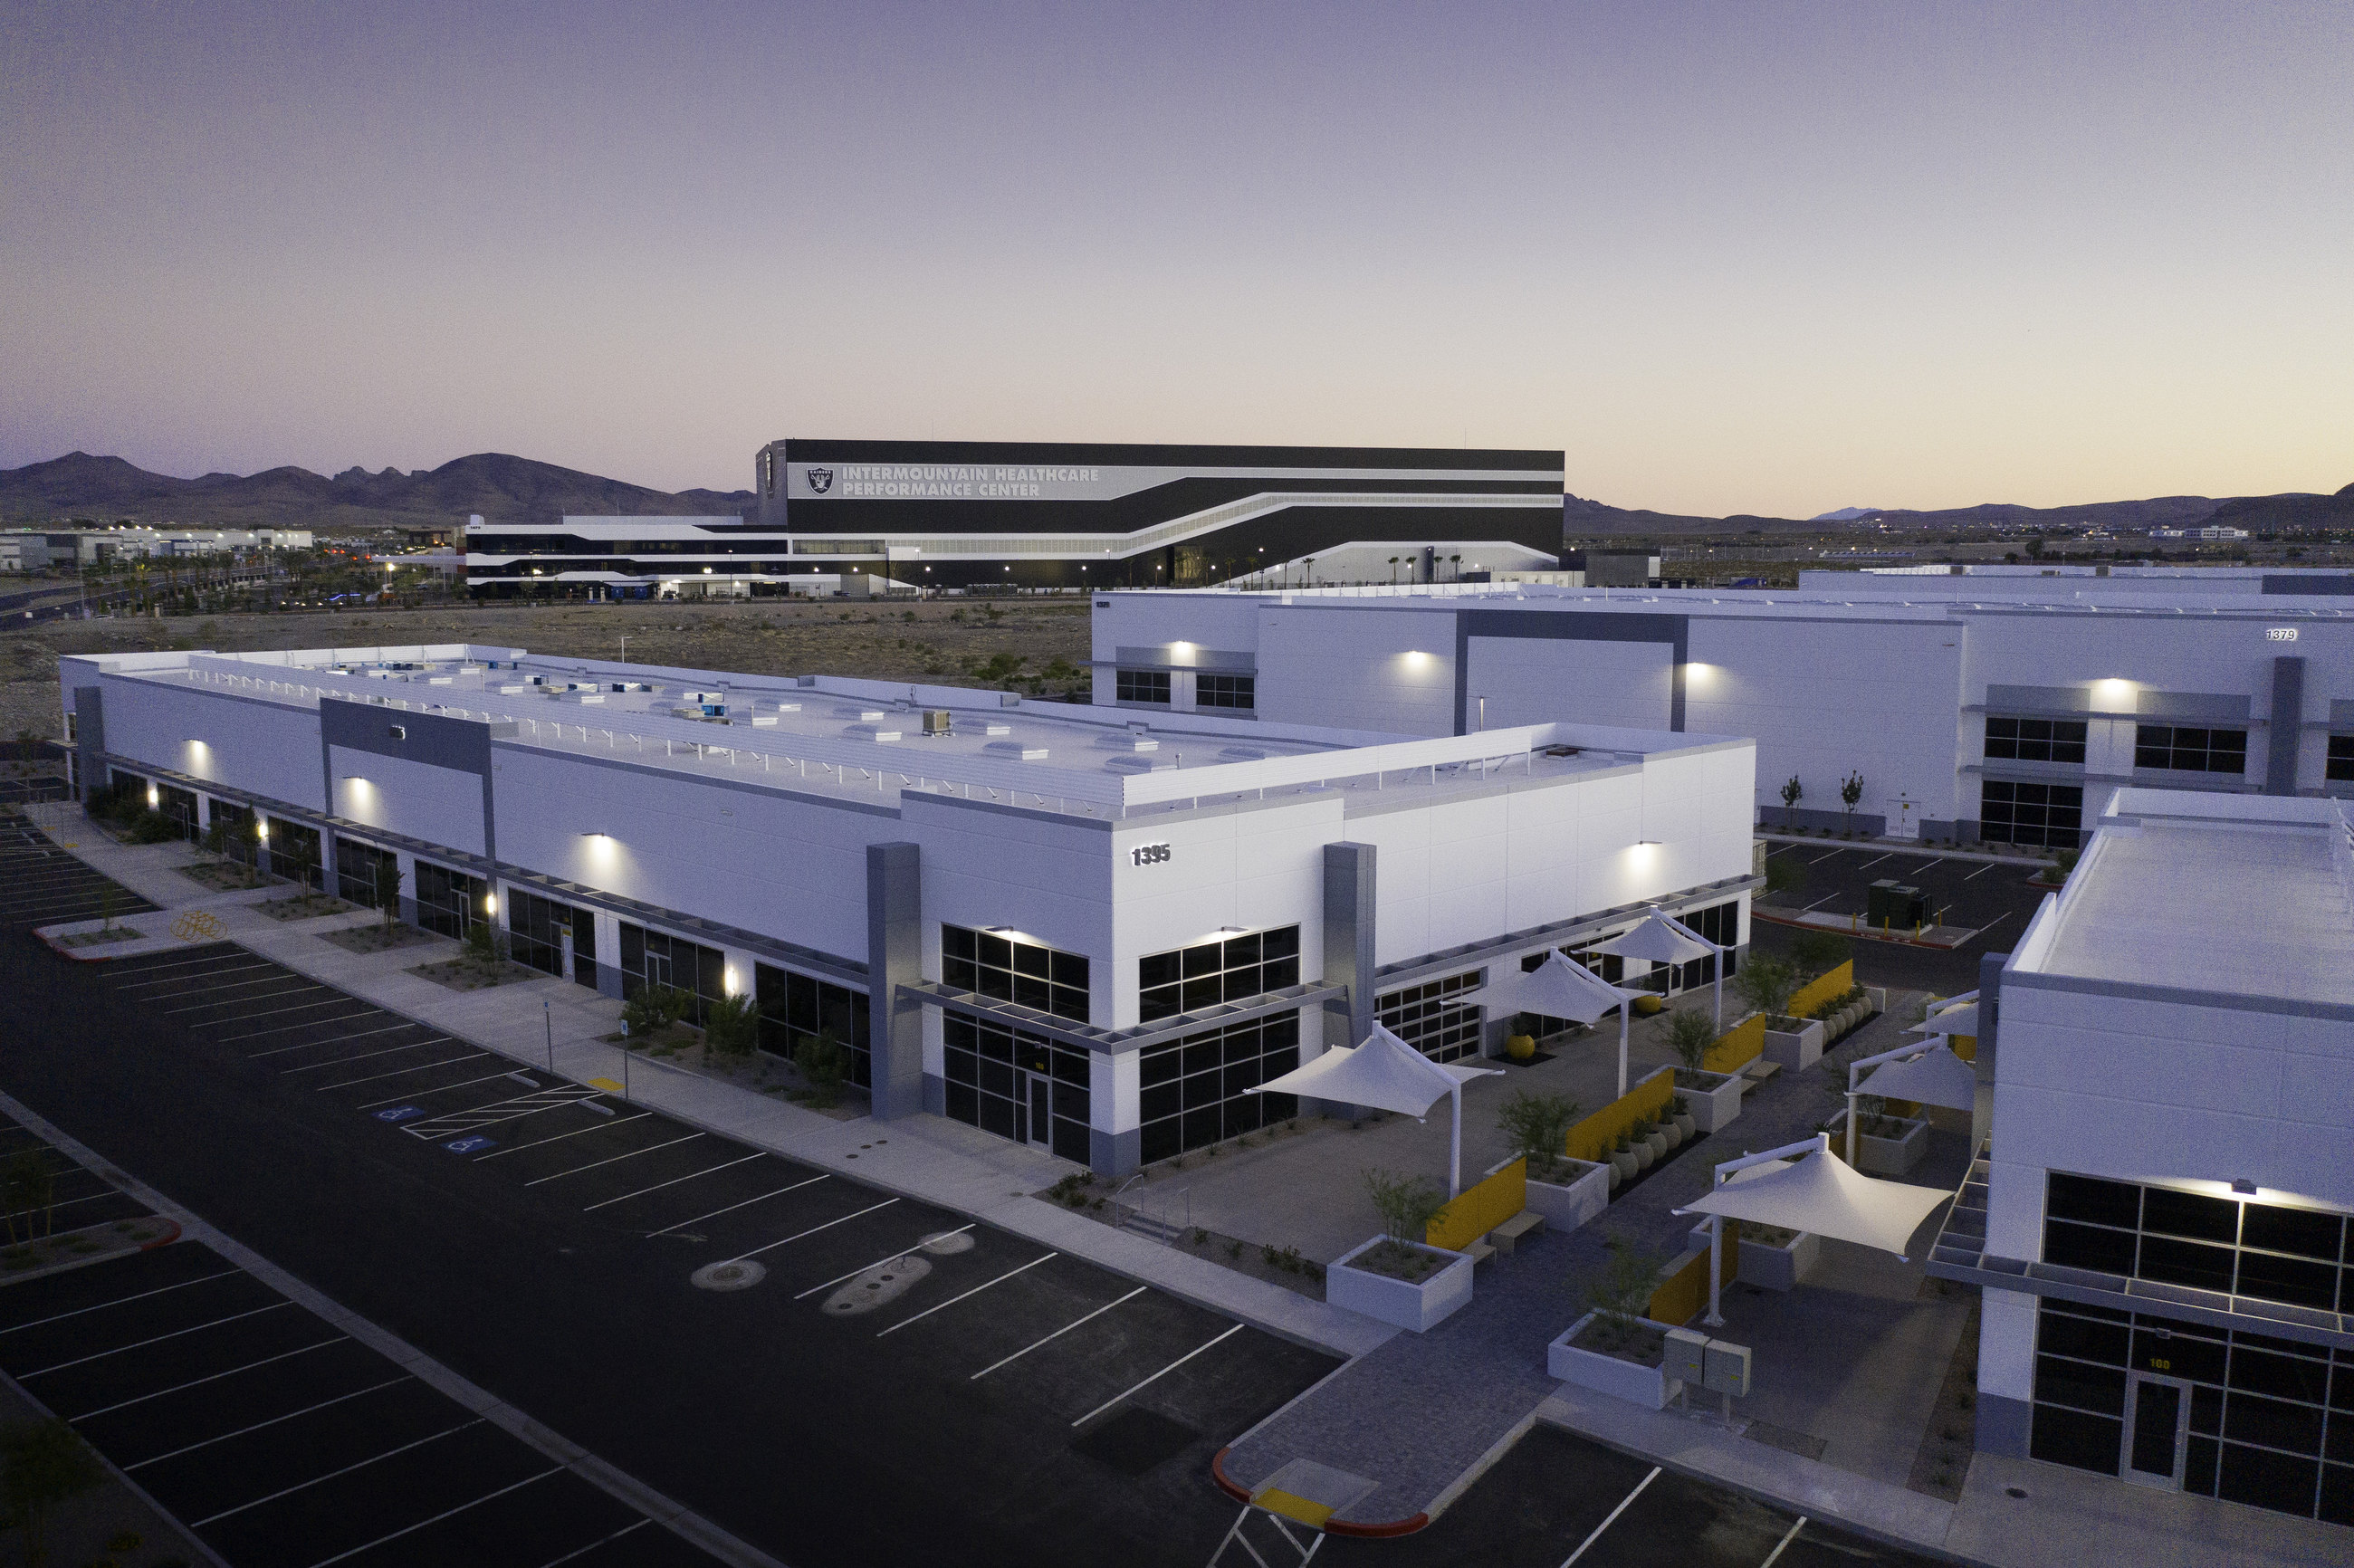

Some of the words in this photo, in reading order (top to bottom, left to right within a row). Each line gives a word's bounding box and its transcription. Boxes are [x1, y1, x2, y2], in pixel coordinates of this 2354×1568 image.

[842, 466, 988, 481] INTERMOUNTAIN
[995, 468, 1099, 482] HEALTHCARE
[842, 483, 971, 496] PERFORMANCE
[978, 483, 1039, 497] CENTER
[2266, 630, 2295, 639] 1379
[1131, 843, 1171, 866] 1395
